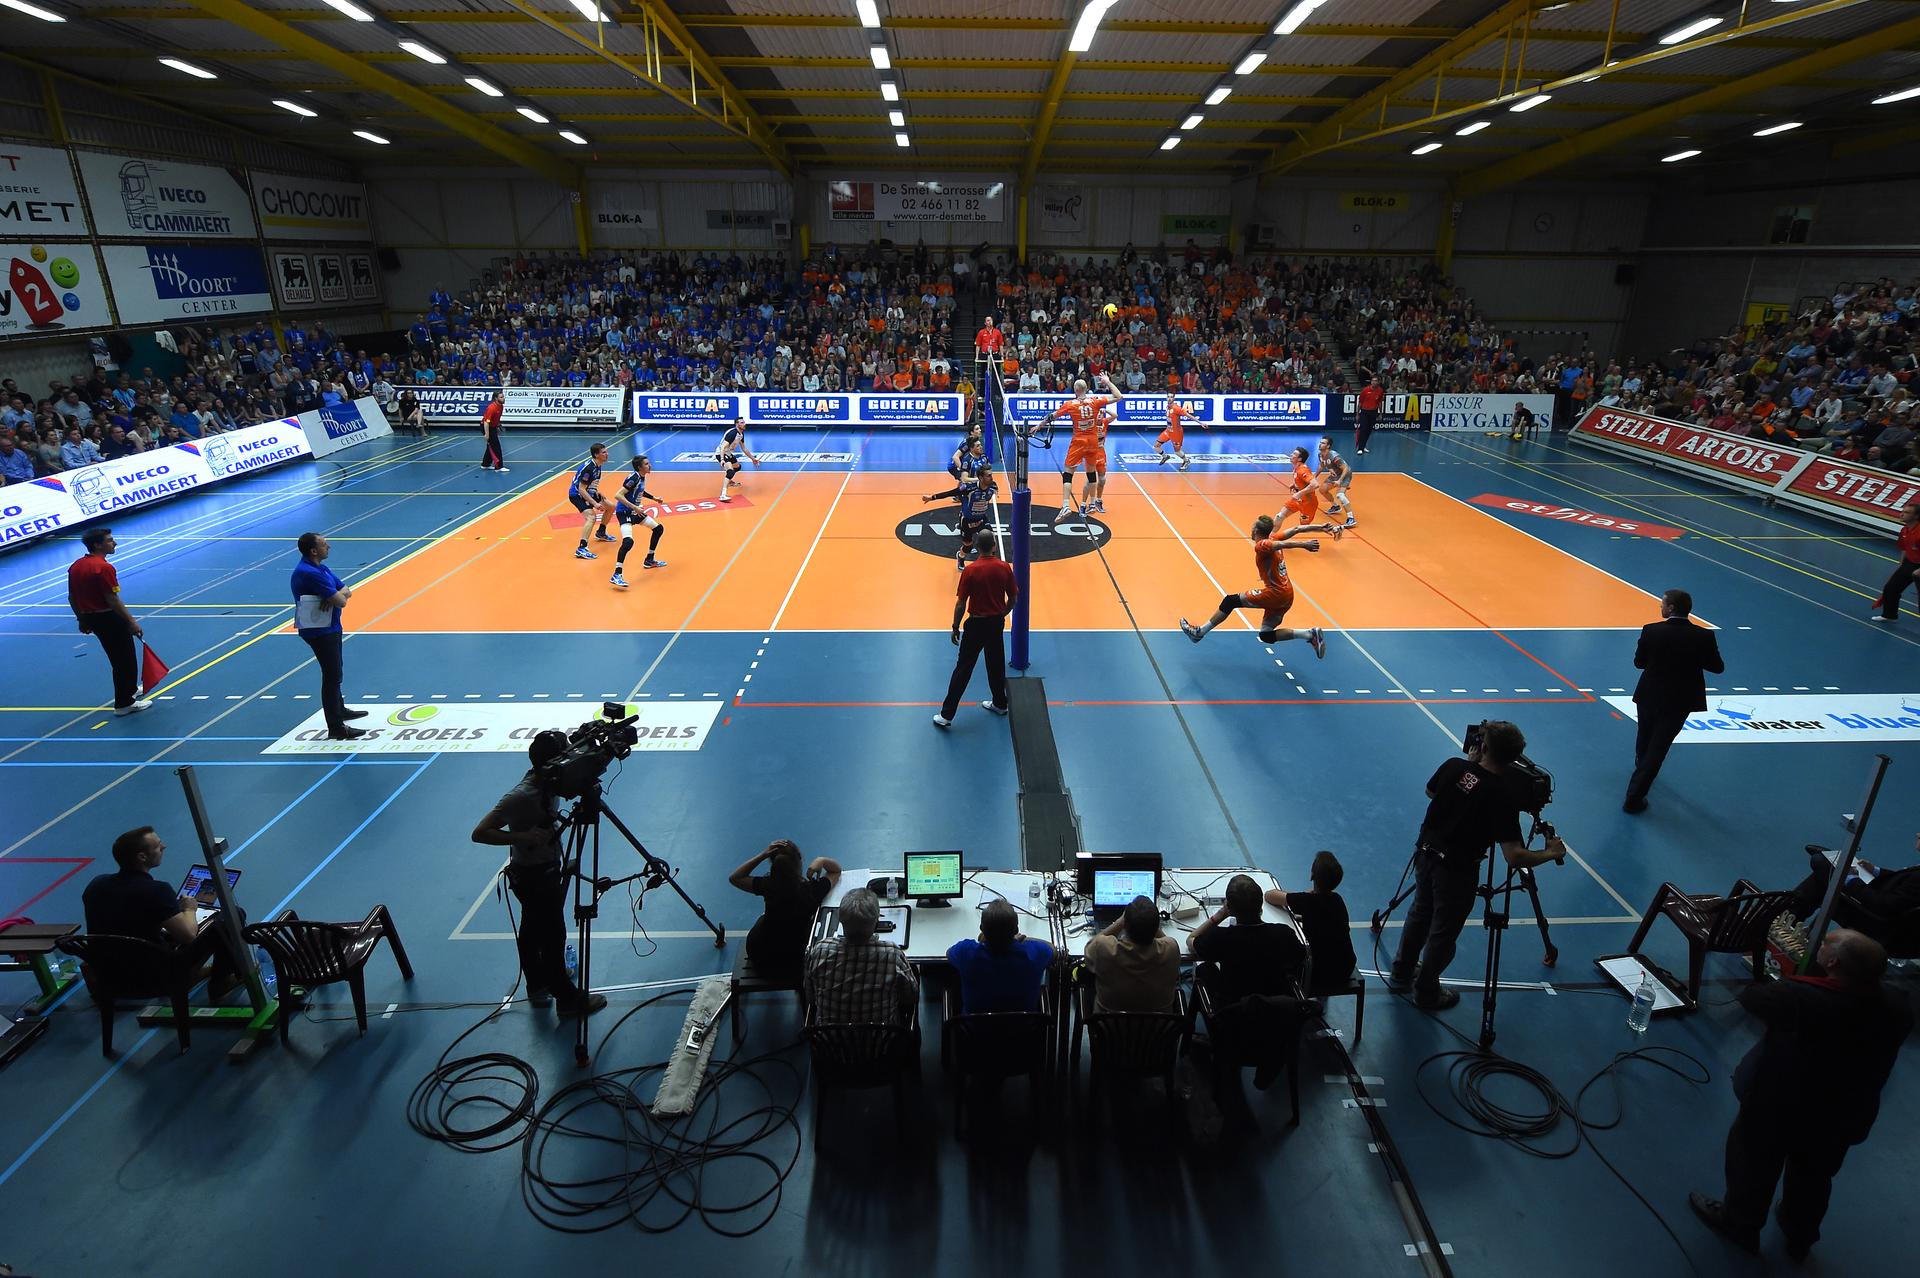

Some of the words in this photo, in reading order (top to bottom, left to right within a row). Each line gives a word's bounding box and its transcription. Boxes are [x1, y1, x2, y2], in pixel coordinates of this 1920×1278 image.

[159, 187, 206, 203] IVECO
[881, 183, 897, 195] De
[262, 187, 361, 218] CHOCOVIT
[902, 199, 916, 210] 02
[921, 199, 943, 210] 466
[948, 199, 960, 210] 11
[965, 199, 979, 210] 82
[143, 214, 231, 232] CAMMAERT
[598, 214, 642, 224] BLOK-A
[182, 299, 238, 314] CENTER
[419, 403, 480, 414] RUCKS
[538, 398, 584, 408] IVECO
[647, 398, 729, 412] GOEIEDAG
[758, 399, 839, 412] GOEIEDAG
[868, 400, 949, 413] GOEIEDAG
[1017, 400, 1067, 410] GOEIE
[1232, 400, 1311, 413] GOEIEDAG
[1343, 394, 1432, 421] GEDAG
[1436, 397, 1483, 410] ASSUR
[1434, 413, 1550, 428] REYGAETS
[238, 436, 279, 454] IVECO
[340, 431, 369, 447] CENTER
[1595, 413, 1671, 446] STELLA
[1676, 434, 1781, 473] ARTOIS
[225, 444, 301, 475] CAMMAERT
[116, 465, 170, 487] IVECO
[99, 474, 199, 511] CAMMAERT
[1741, 719, 1826, 730] water
[393, 727, 488, 741] ROELS
[277, 743, 370, 753] partner
[380, 742, 401, 752] in
[410, 742, 472, 752] print
